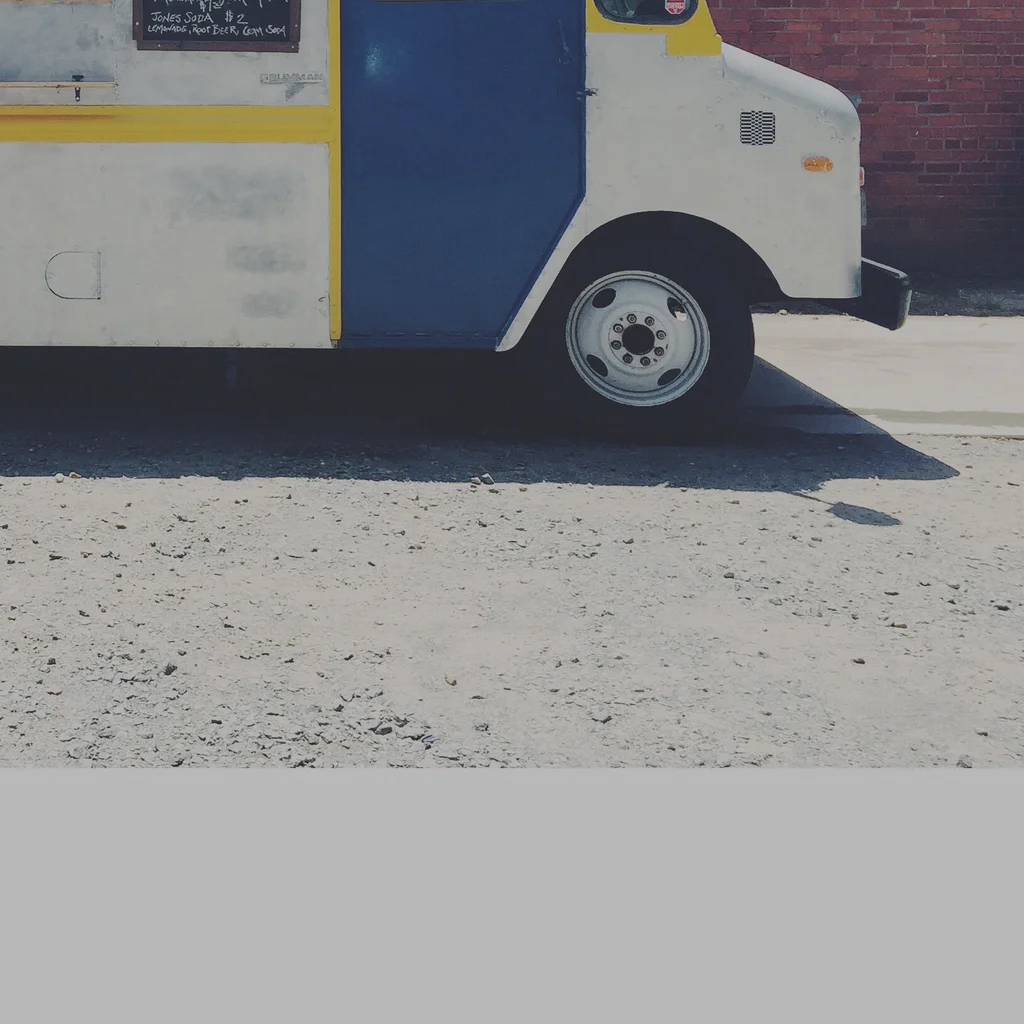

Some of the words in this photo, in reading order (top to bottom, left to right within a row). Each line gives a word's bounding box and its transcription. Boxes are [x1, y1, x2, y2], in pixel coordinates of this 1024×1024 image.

[150, 11, 182, 23] JONES
[183, 11, 214, 23] SODA
[265, 23, 287, 37] SODA
